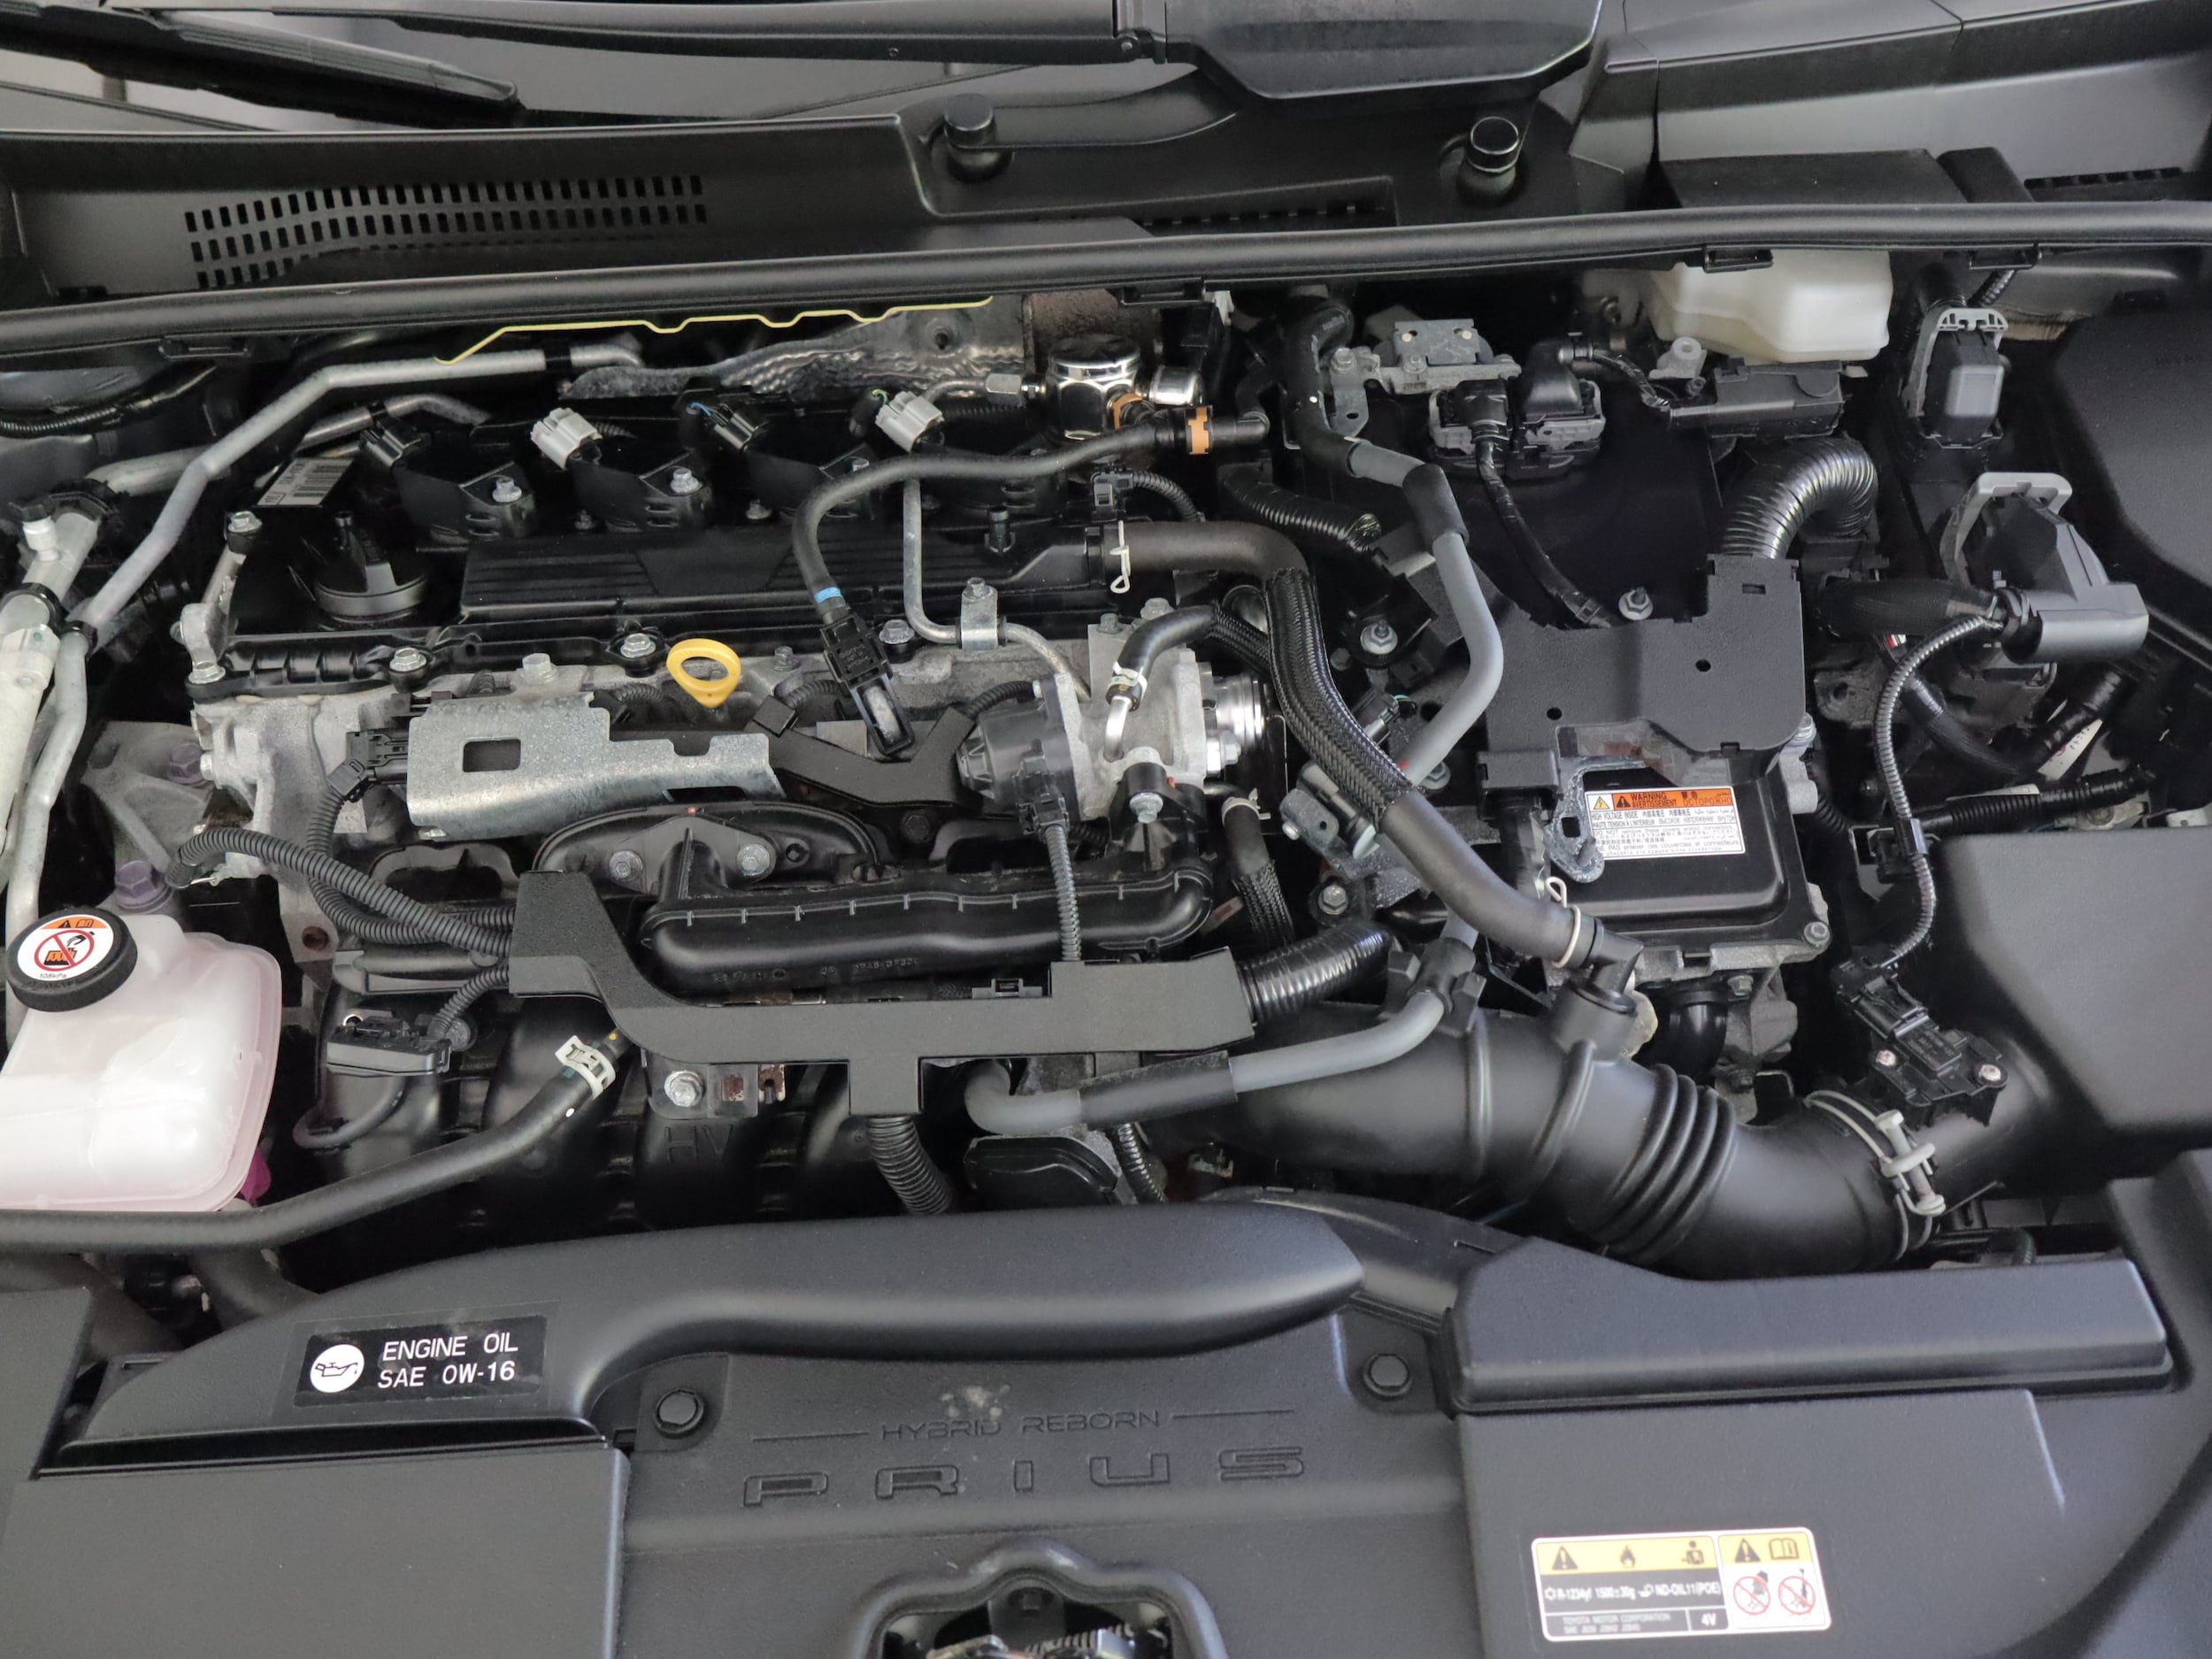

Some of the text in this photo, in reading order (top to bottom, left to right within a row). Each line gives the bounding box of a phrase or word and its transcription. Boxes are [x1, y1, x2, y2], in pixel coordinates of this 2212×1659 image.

[382, 1332, 518, 1362] ENGINE OIL
[377, 1360, 516, 1389] SAE 0W-16
[881, 1409, 1161, 1442] HYBRID REBORN
[742, 1446, 1306, 1508] PRIUS
